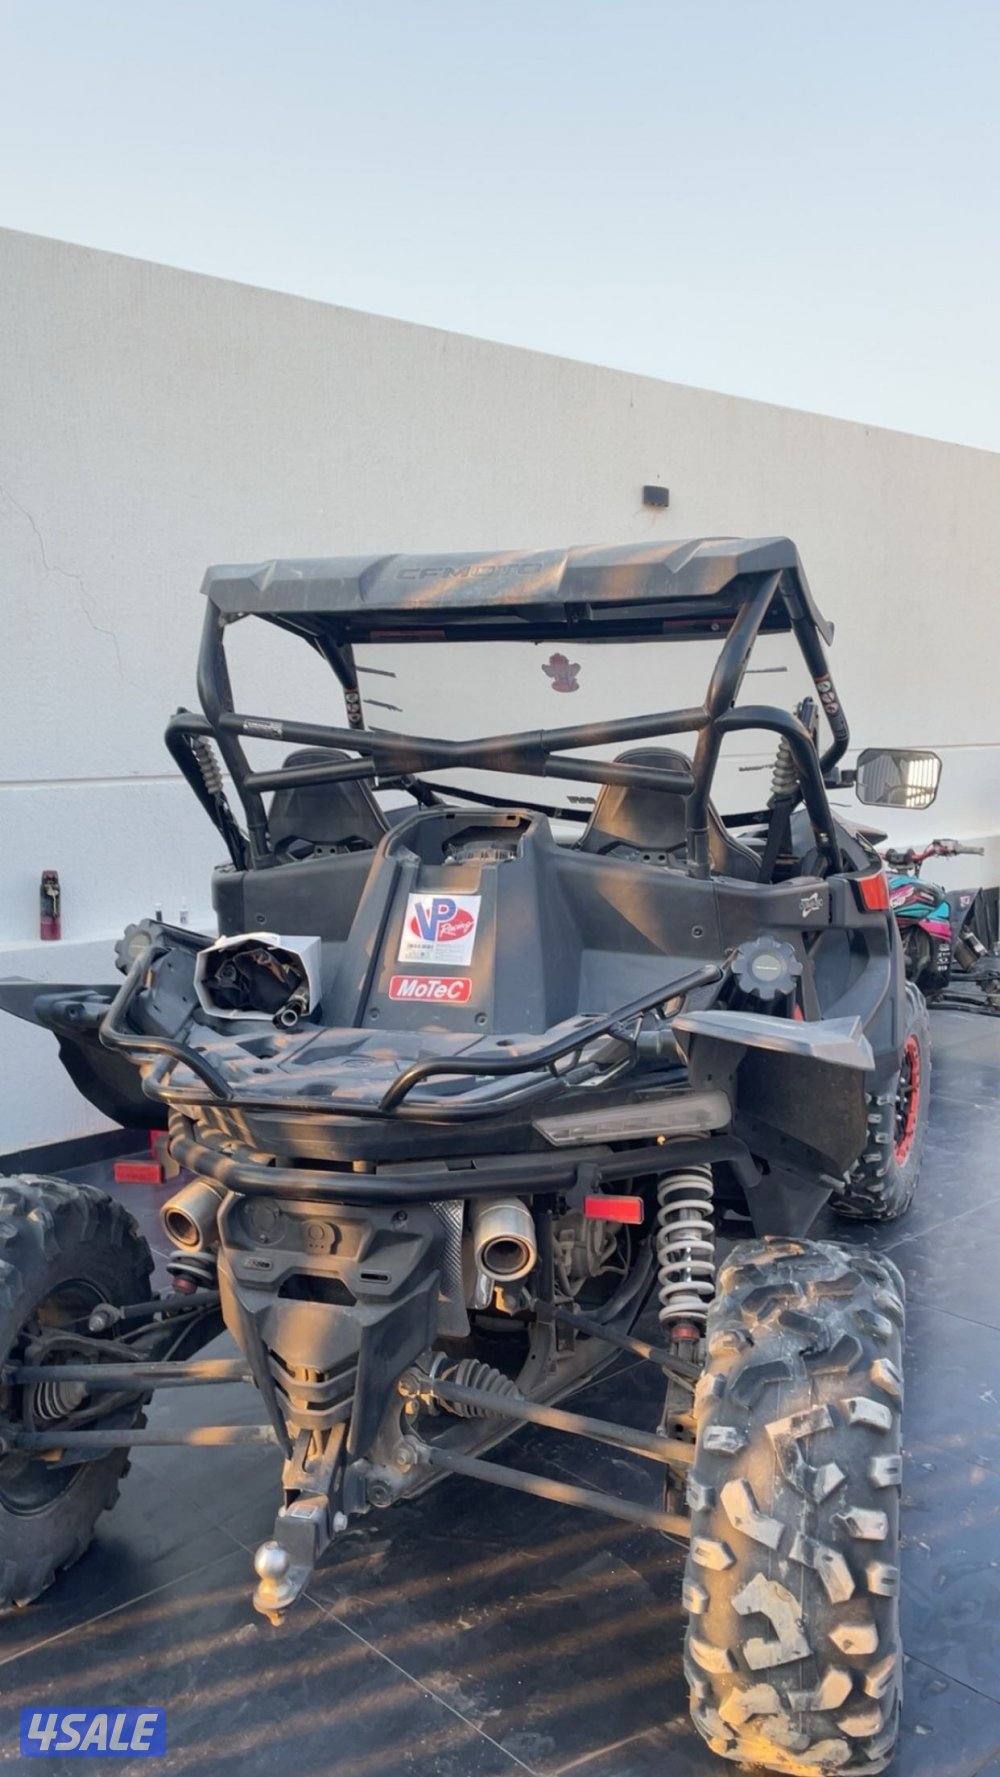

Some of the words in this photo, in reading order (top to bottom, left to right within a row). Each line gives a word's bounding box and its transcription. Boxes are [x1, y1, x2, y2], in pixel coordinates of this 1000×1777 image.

[414, 898, 457, 942] VP
[440, 920, 474, 938] Racing
[397, 979, 465, 999] MoTeC
